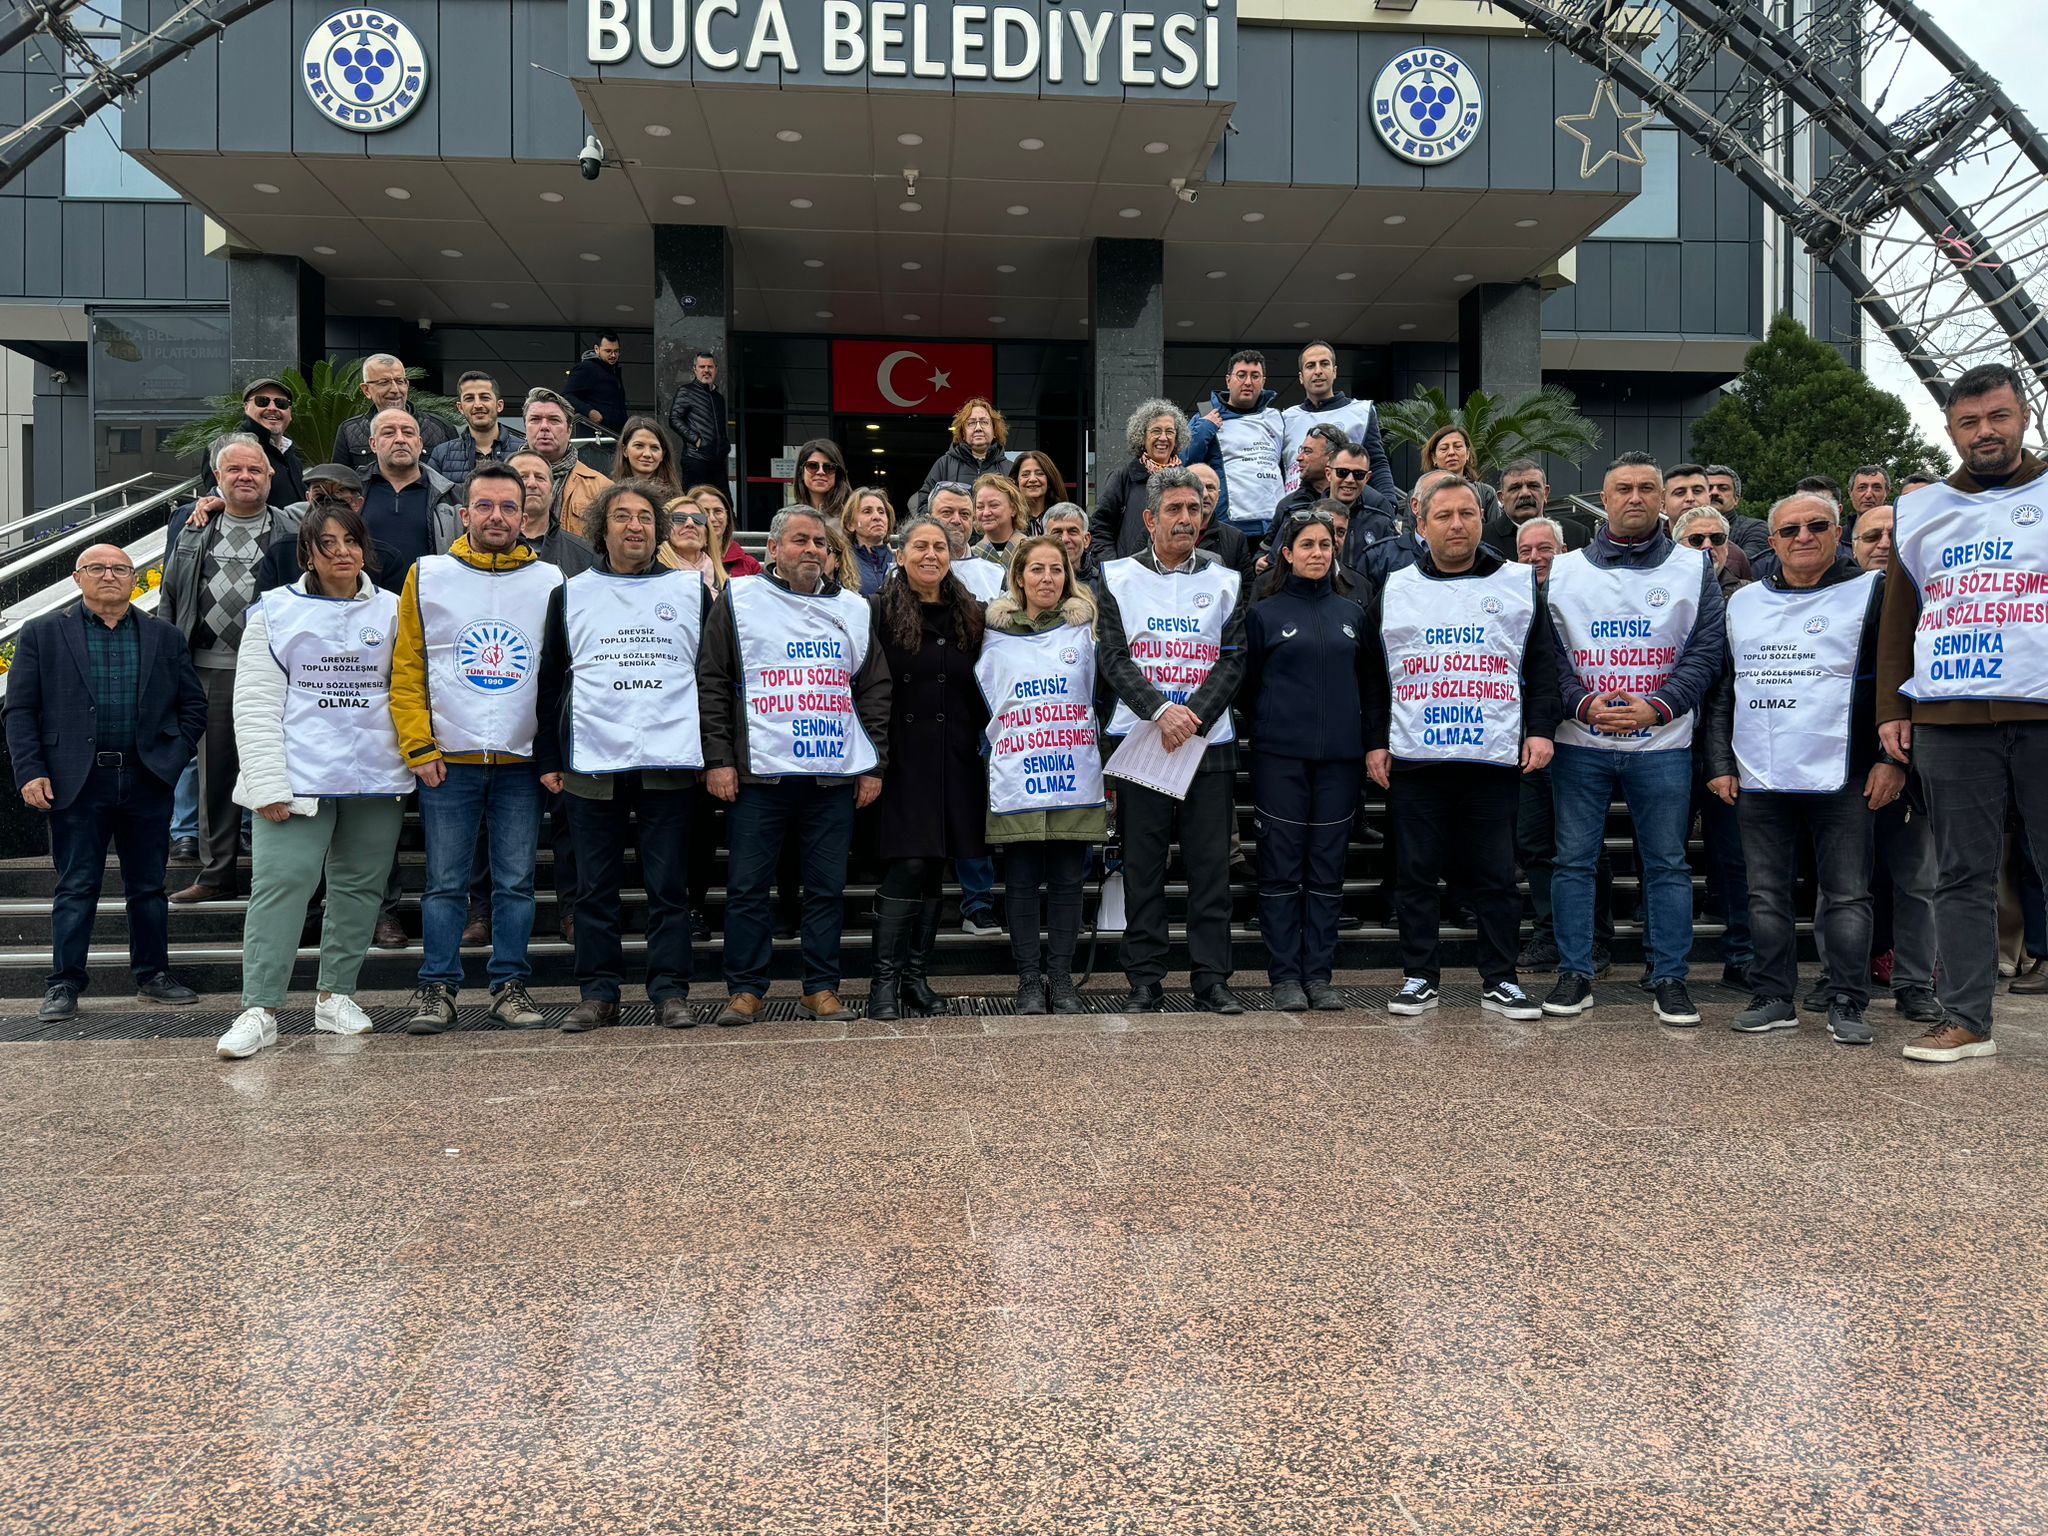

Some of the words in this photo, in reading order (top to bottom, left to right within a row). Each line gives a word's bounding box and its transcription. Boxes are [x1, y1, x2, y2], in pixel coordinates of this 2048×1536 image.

[327, 13, 399, 40] BUCA
[588, 0, 799, 72] BUCA
[821, 0, 1219, 88] BELEDİYESİ
[1395, 53, 1459, 78] BUCA
[1942, 537, 2013, 568] GREVSİZ
[1925, 577, 1954, 604] TOPLU
[1958, 570, 2048, 598] SÖZLEŞME
[1147, 616, 1200, 633] GREVSİZ
[1947, 601, 2048, 628] SÖZLEŞMES
[1426, 623, 1484, 644] GREVSİZ
[1591, 616, 1652, 638] GREVSİZ
[629, 636, 672, 644] SÖZLEŞME
[787, 638, 841, 659] GREVSİZ
[1129, 641, 1162, 659] TOPLU
[1760, 644, 1797, 652] GREVSİZ
[1933, 629, 2003, 657] SENDİKA
[594, 653, 620, 661] TOPLU
[623, 652, 678, 662] SÖZLEŞMESİZ
[618, 659, 656, 667] SENDİKA
[1402, 655, 1439, 675] TOPLU
[1444, 651, 1508, 676] SÖZLEŞME
[1573, 649, 1605, 667] OPLU
[1610, 645, 1676, 670] SÖZLEŞME
[1769, 653, 1816, 661] SÖZLEŞME
[301, 664, 330, 672] TOPLU
[333, 664, 378, 672] SÖZLEŞME
[486, 670, 522, 679] BEL-SEN
[760, 669, 803, 687] TOPLU
[1761, 669, 1822, 677] SÖZLEŞMESİZ
[1931, 658, 2003, 681] OLMAZ
[297, 681, 323, 689] TOPLU
[326, 681, 384, 689] SÖZLEŞMESİZ
[613, 680, 663, 690] OLMAZ
[1015, 674, 1068, 699] GREVSİZ
[1396, 682, 1428, 702] TOPLU
[1432, 677, 1517, 702] SÖZLEŞMESİZ
[318, 698, 370, 709] OLMAZ
[752, 694, 794, 714] TOPLU
[1424, 702, 1484, 724] SENDİKA
[1749, 699, 1797, 709] OLMAZ
[792, 716, 844, 737] SENDİKA
[998, 708, 1032, 730] TOPLU
[1035, 702, 1089, 725] SÖZLEŞME
[995, 734, 1025, 756] TOPLU
[1028, 726, 1095, 751] SÖZLEŞMESİZ
[1424, 727, 1484, 746] OLMAZ
[793, 740, 844, 758] OLMAZ
[1024, 751, 1075, 774] SENDİKA
[1025, 775, 1076, 795] OLMAZ
